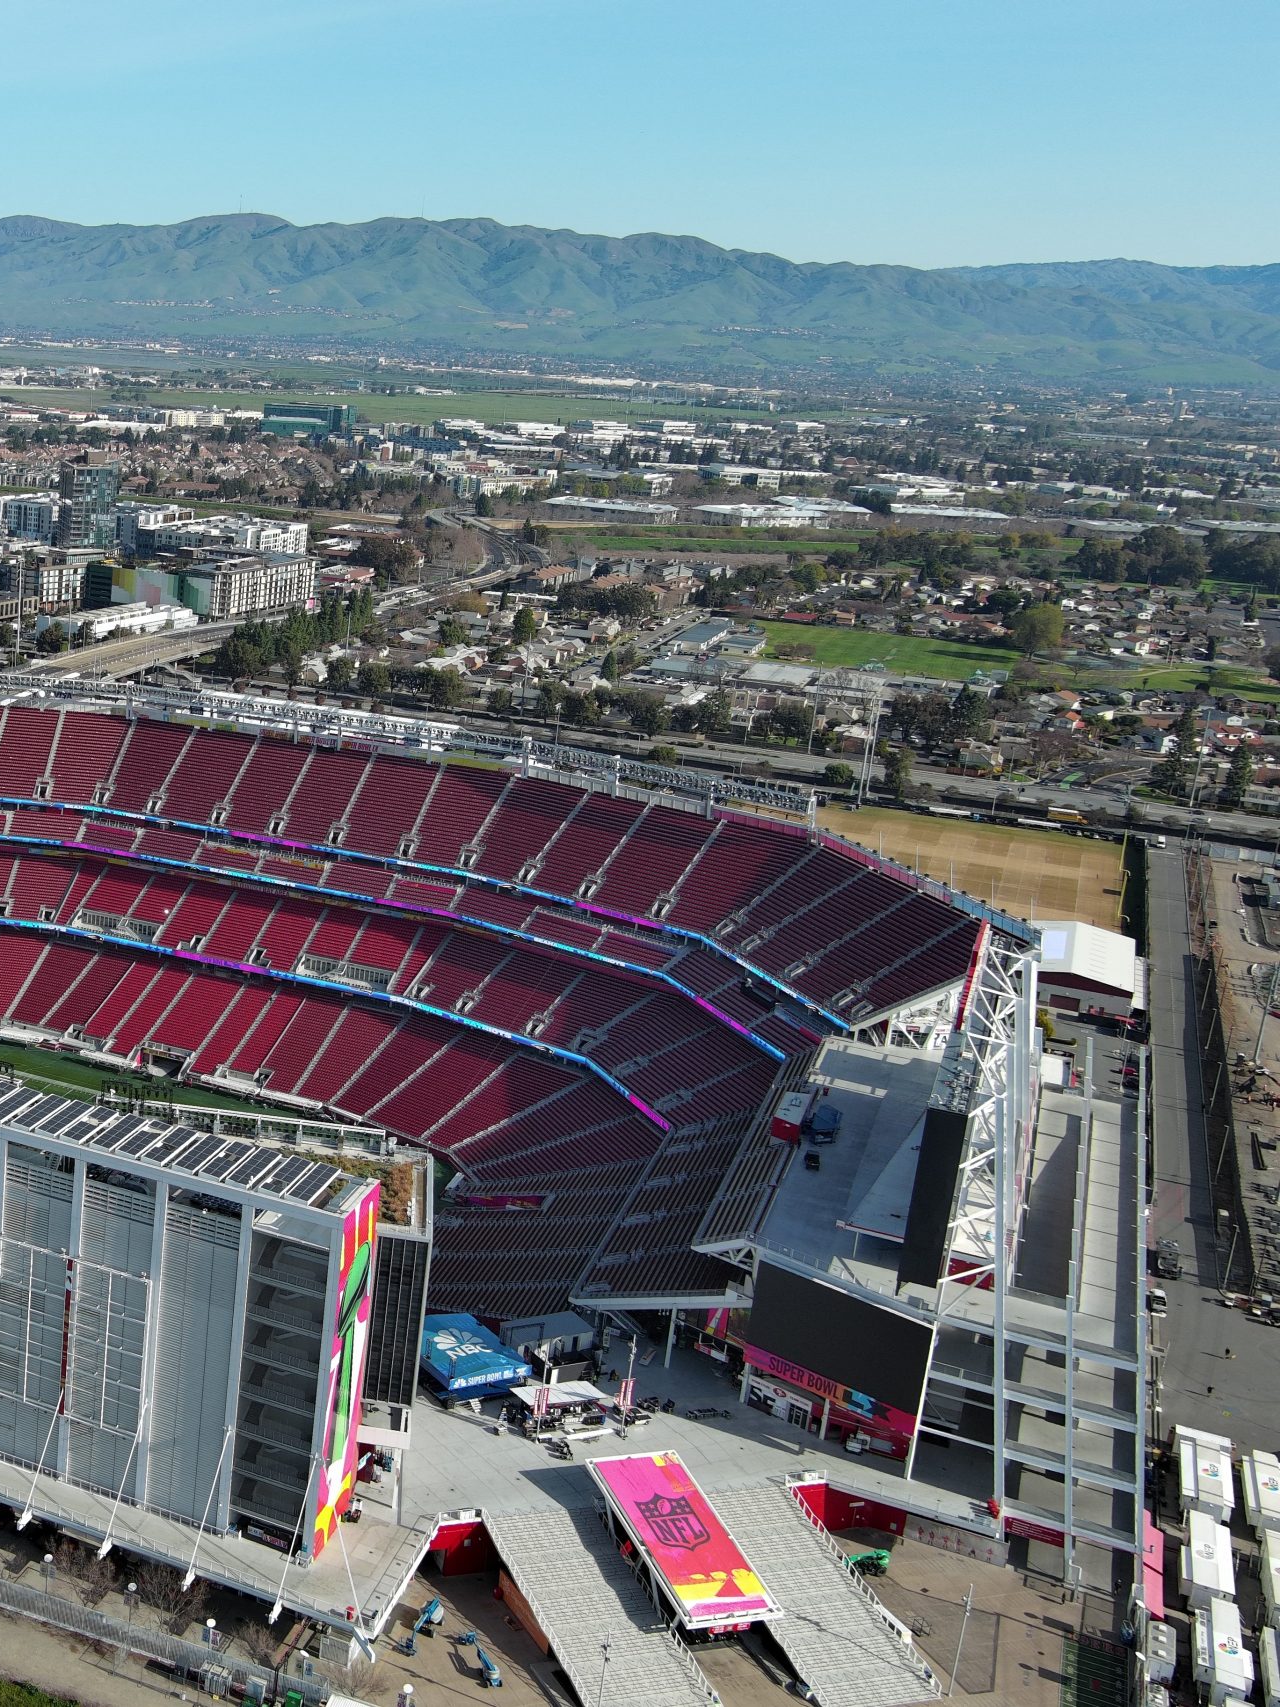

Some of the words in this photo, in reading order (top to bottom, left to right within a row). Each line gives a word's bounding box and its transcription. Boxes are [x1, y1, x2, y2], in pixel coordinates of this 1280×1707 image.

[54, 690, 72, 699] VISA
[446, 1344, 493, 1359] NBC
[468, 1375, 486, 1386] SUPER
[487, 1372, 502, 1382] BOWL
[769, 1356, 805, 1383] SUPER
[807, 1374, 840, 1400] BOWL
[650, 1515, 704, 1542] NFL
